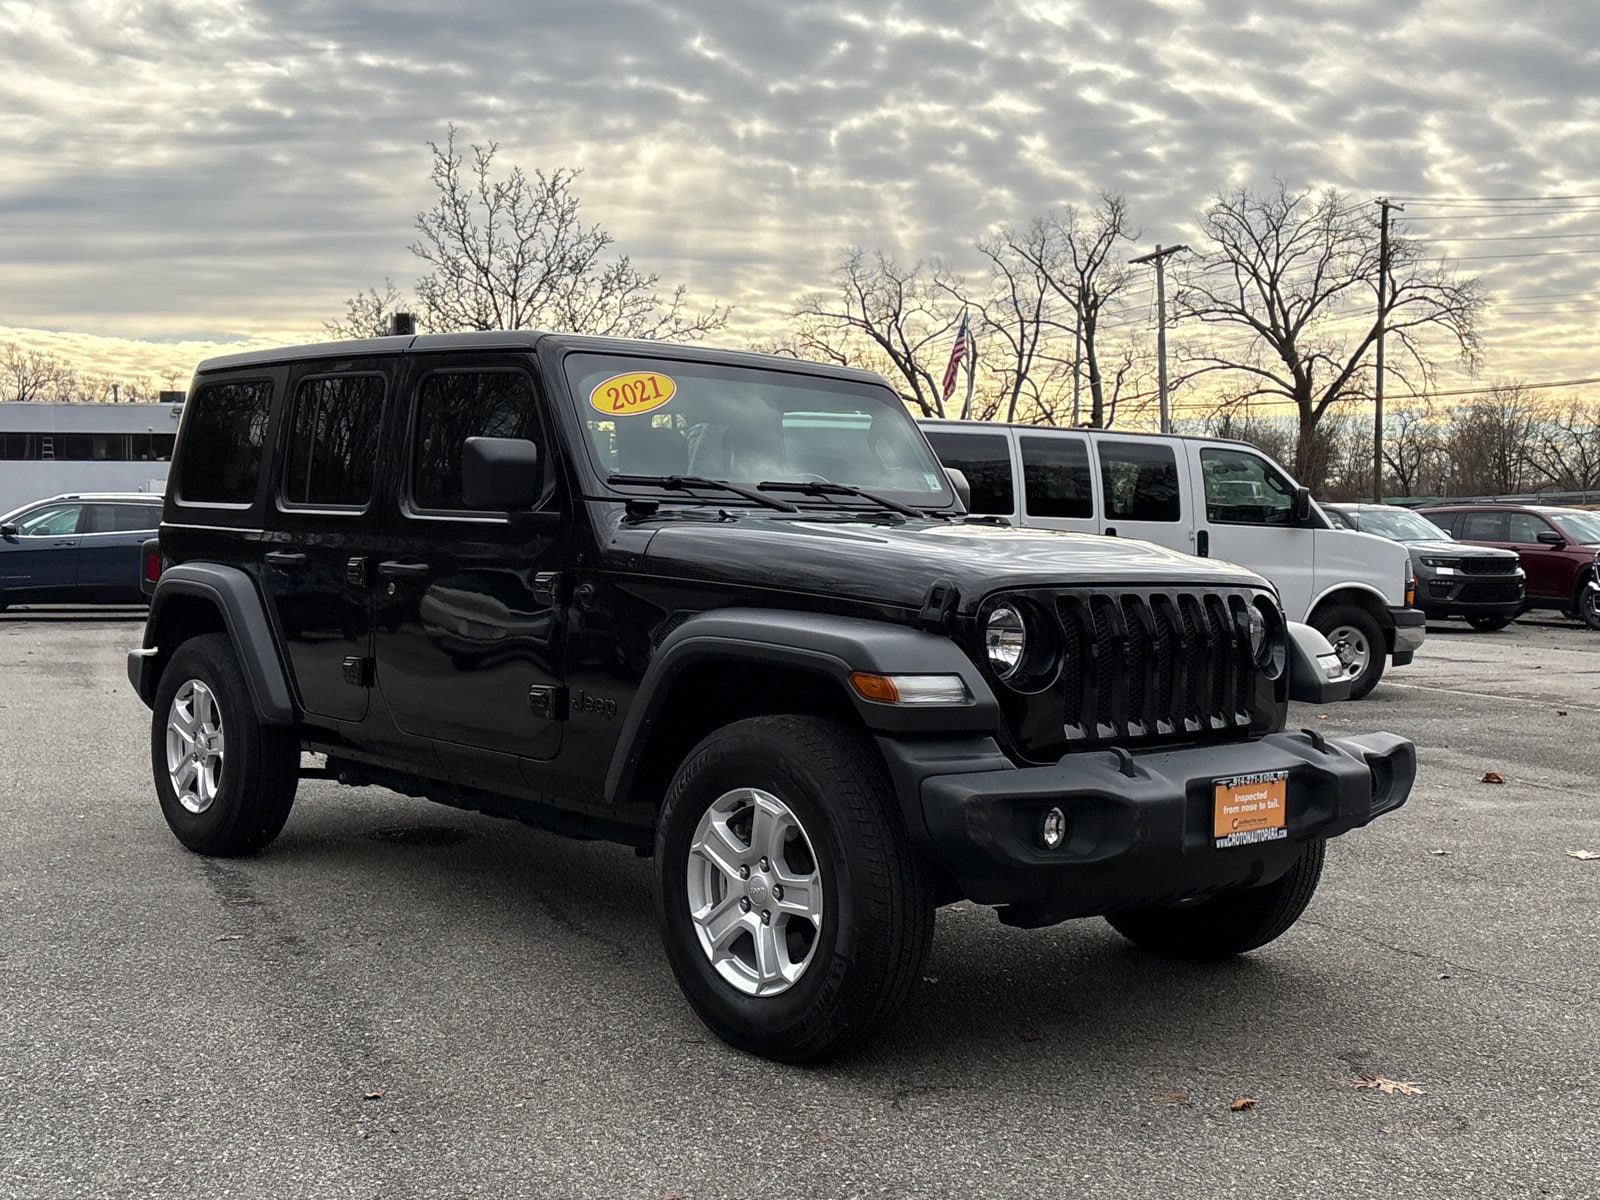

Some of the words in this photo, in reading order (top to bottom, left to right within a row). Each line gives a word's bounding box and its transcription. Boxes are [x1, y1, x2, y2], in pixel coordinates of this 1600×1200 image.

[606, 376, 664, 410] 2021
[571, 689, 616, 719] Jeep
[1223, 805, 1240, 815] from
[1241, 803, 1257, 812] nose
[1267, 798, 1280, 808] tail.
[1234, 790, 1268, 803] Inspected
